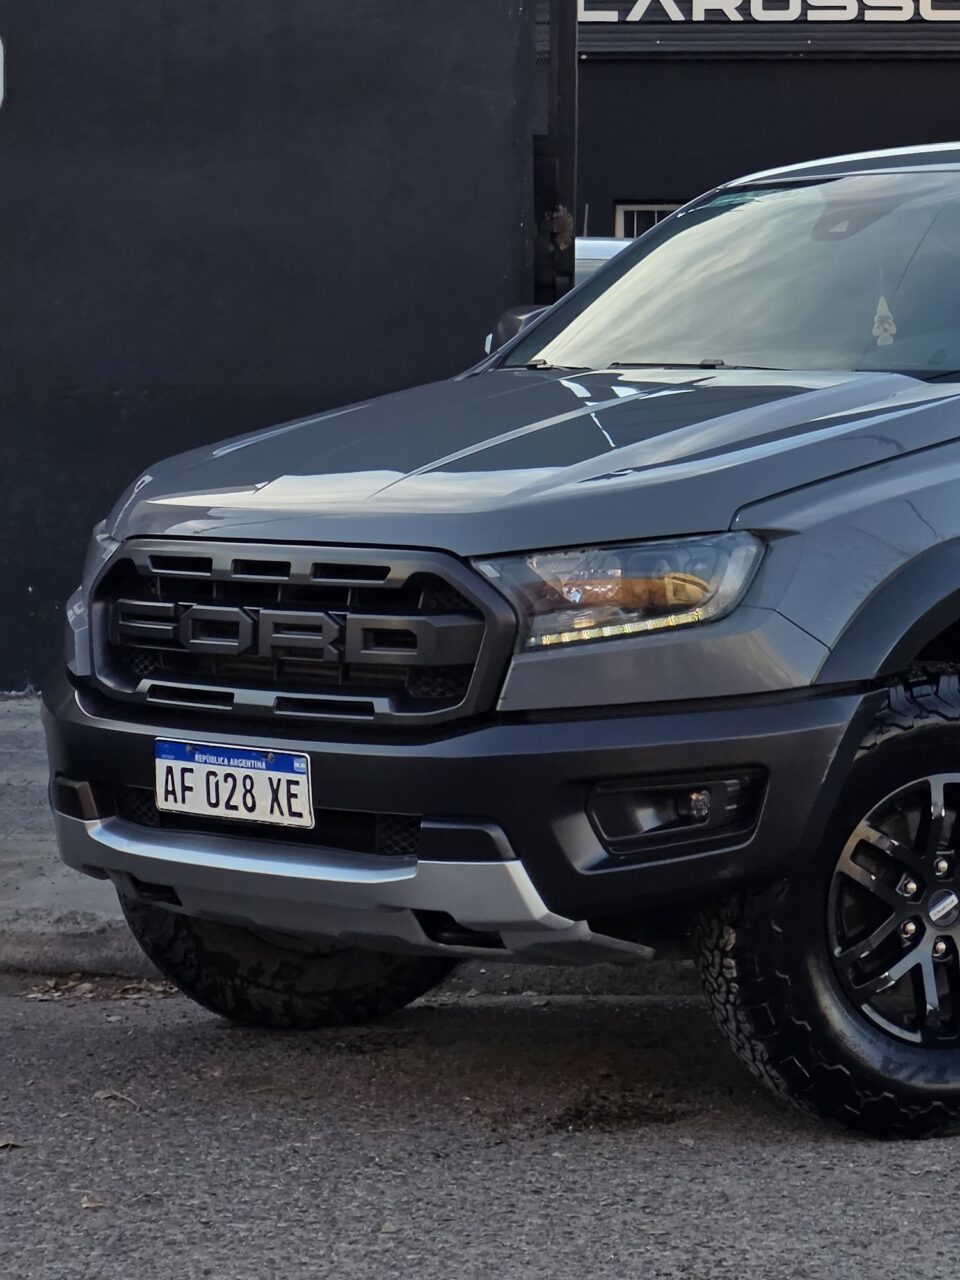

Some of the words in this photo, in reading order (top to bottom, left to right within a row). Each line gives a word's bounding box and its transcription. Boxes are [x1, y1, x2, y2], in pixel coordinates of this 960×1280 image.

[110, 598, 442, 664] FORD
[229, 758, 267, 769] ARGENTINA
[164, 765, 194, 804] AF
[205, 770, 257, 813] 028
[268, 776, 304, 818] XE
